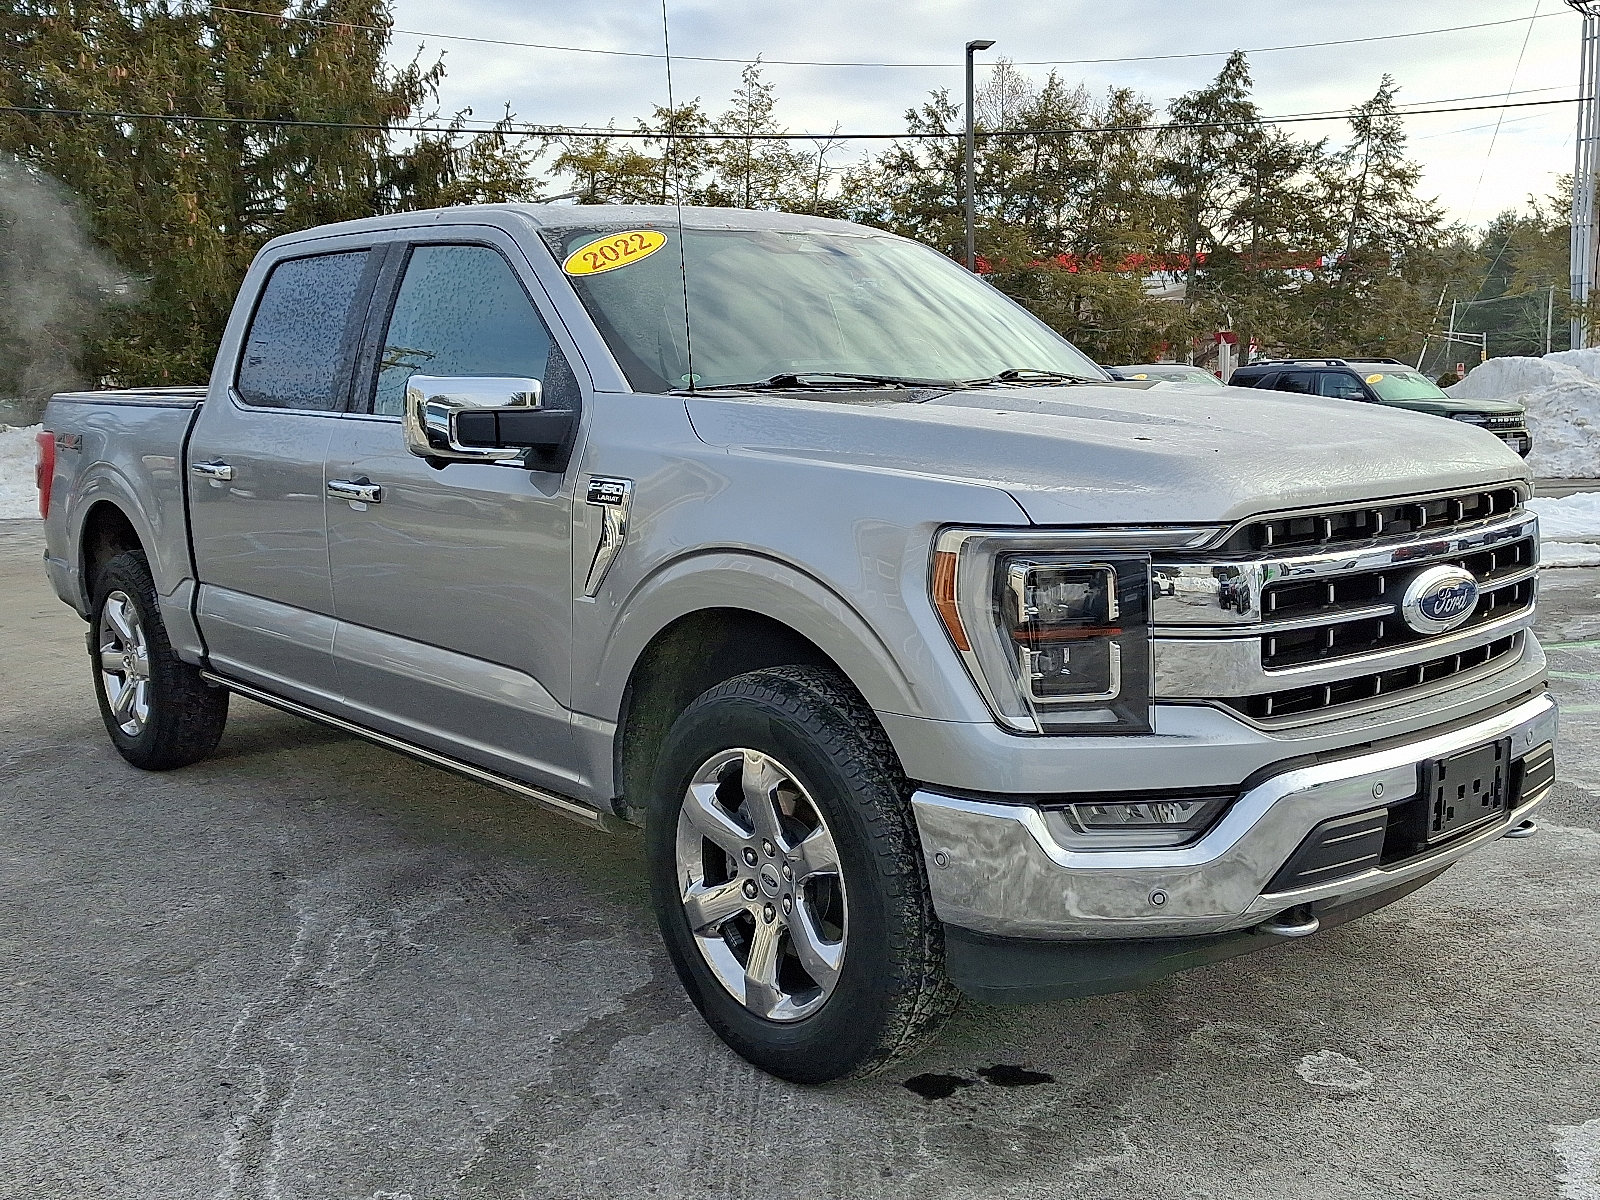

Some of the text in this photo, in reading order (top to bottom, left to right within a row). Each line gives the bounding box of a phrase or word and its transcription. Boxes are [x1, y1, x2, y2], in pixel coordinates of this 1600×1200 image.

[583, 233, 653, 270] 2022
[589, 483, 623, 495] F-150
[597, 494, 620, 502] LARIAT
[1434, 585, 1468, 614] Ford
